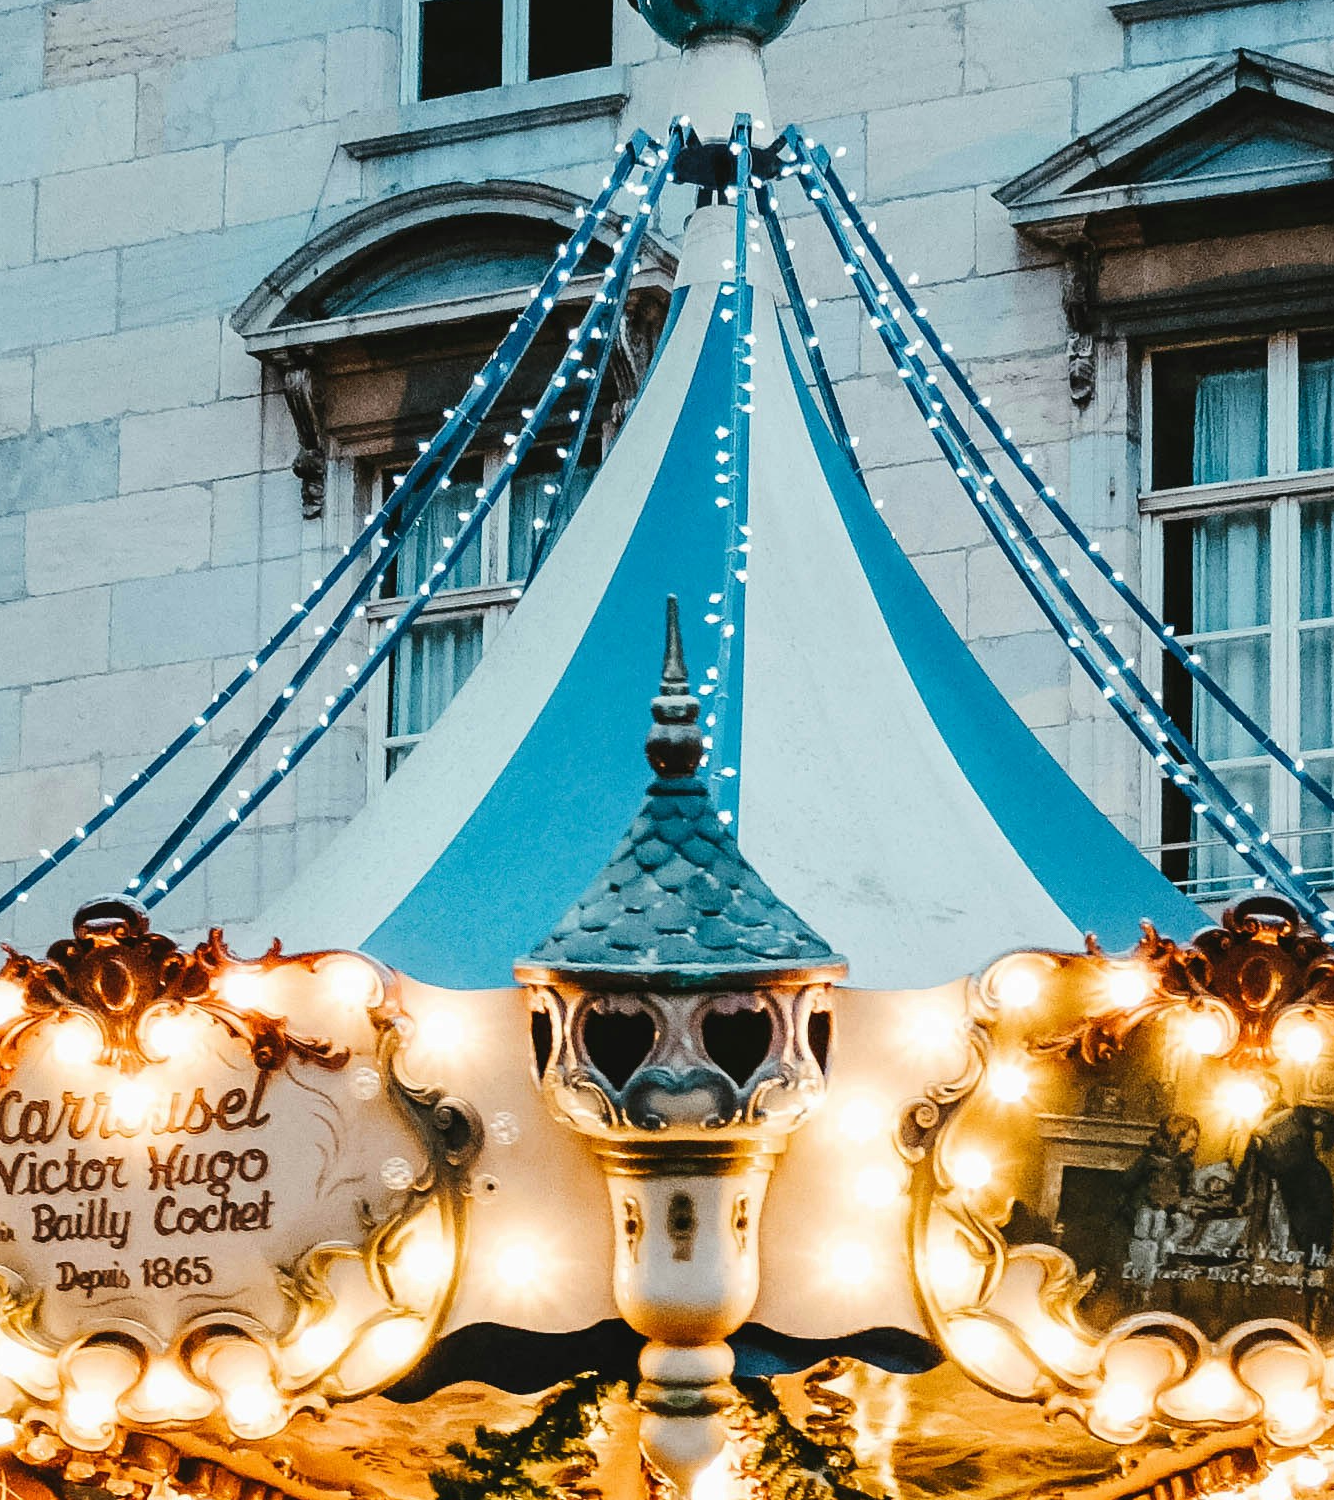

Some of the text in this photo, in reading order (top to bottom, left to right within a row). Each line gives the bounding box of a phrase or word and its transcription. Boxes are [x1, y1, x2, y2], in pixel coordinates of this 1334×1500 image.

[147, 1144, 269, 1196] Hugo
[32, 1197, 131, 1250] Bailly
[154, 1189, 275, 1237] Cochet
[56, 1256, 213, 1298] Depuis 1865
